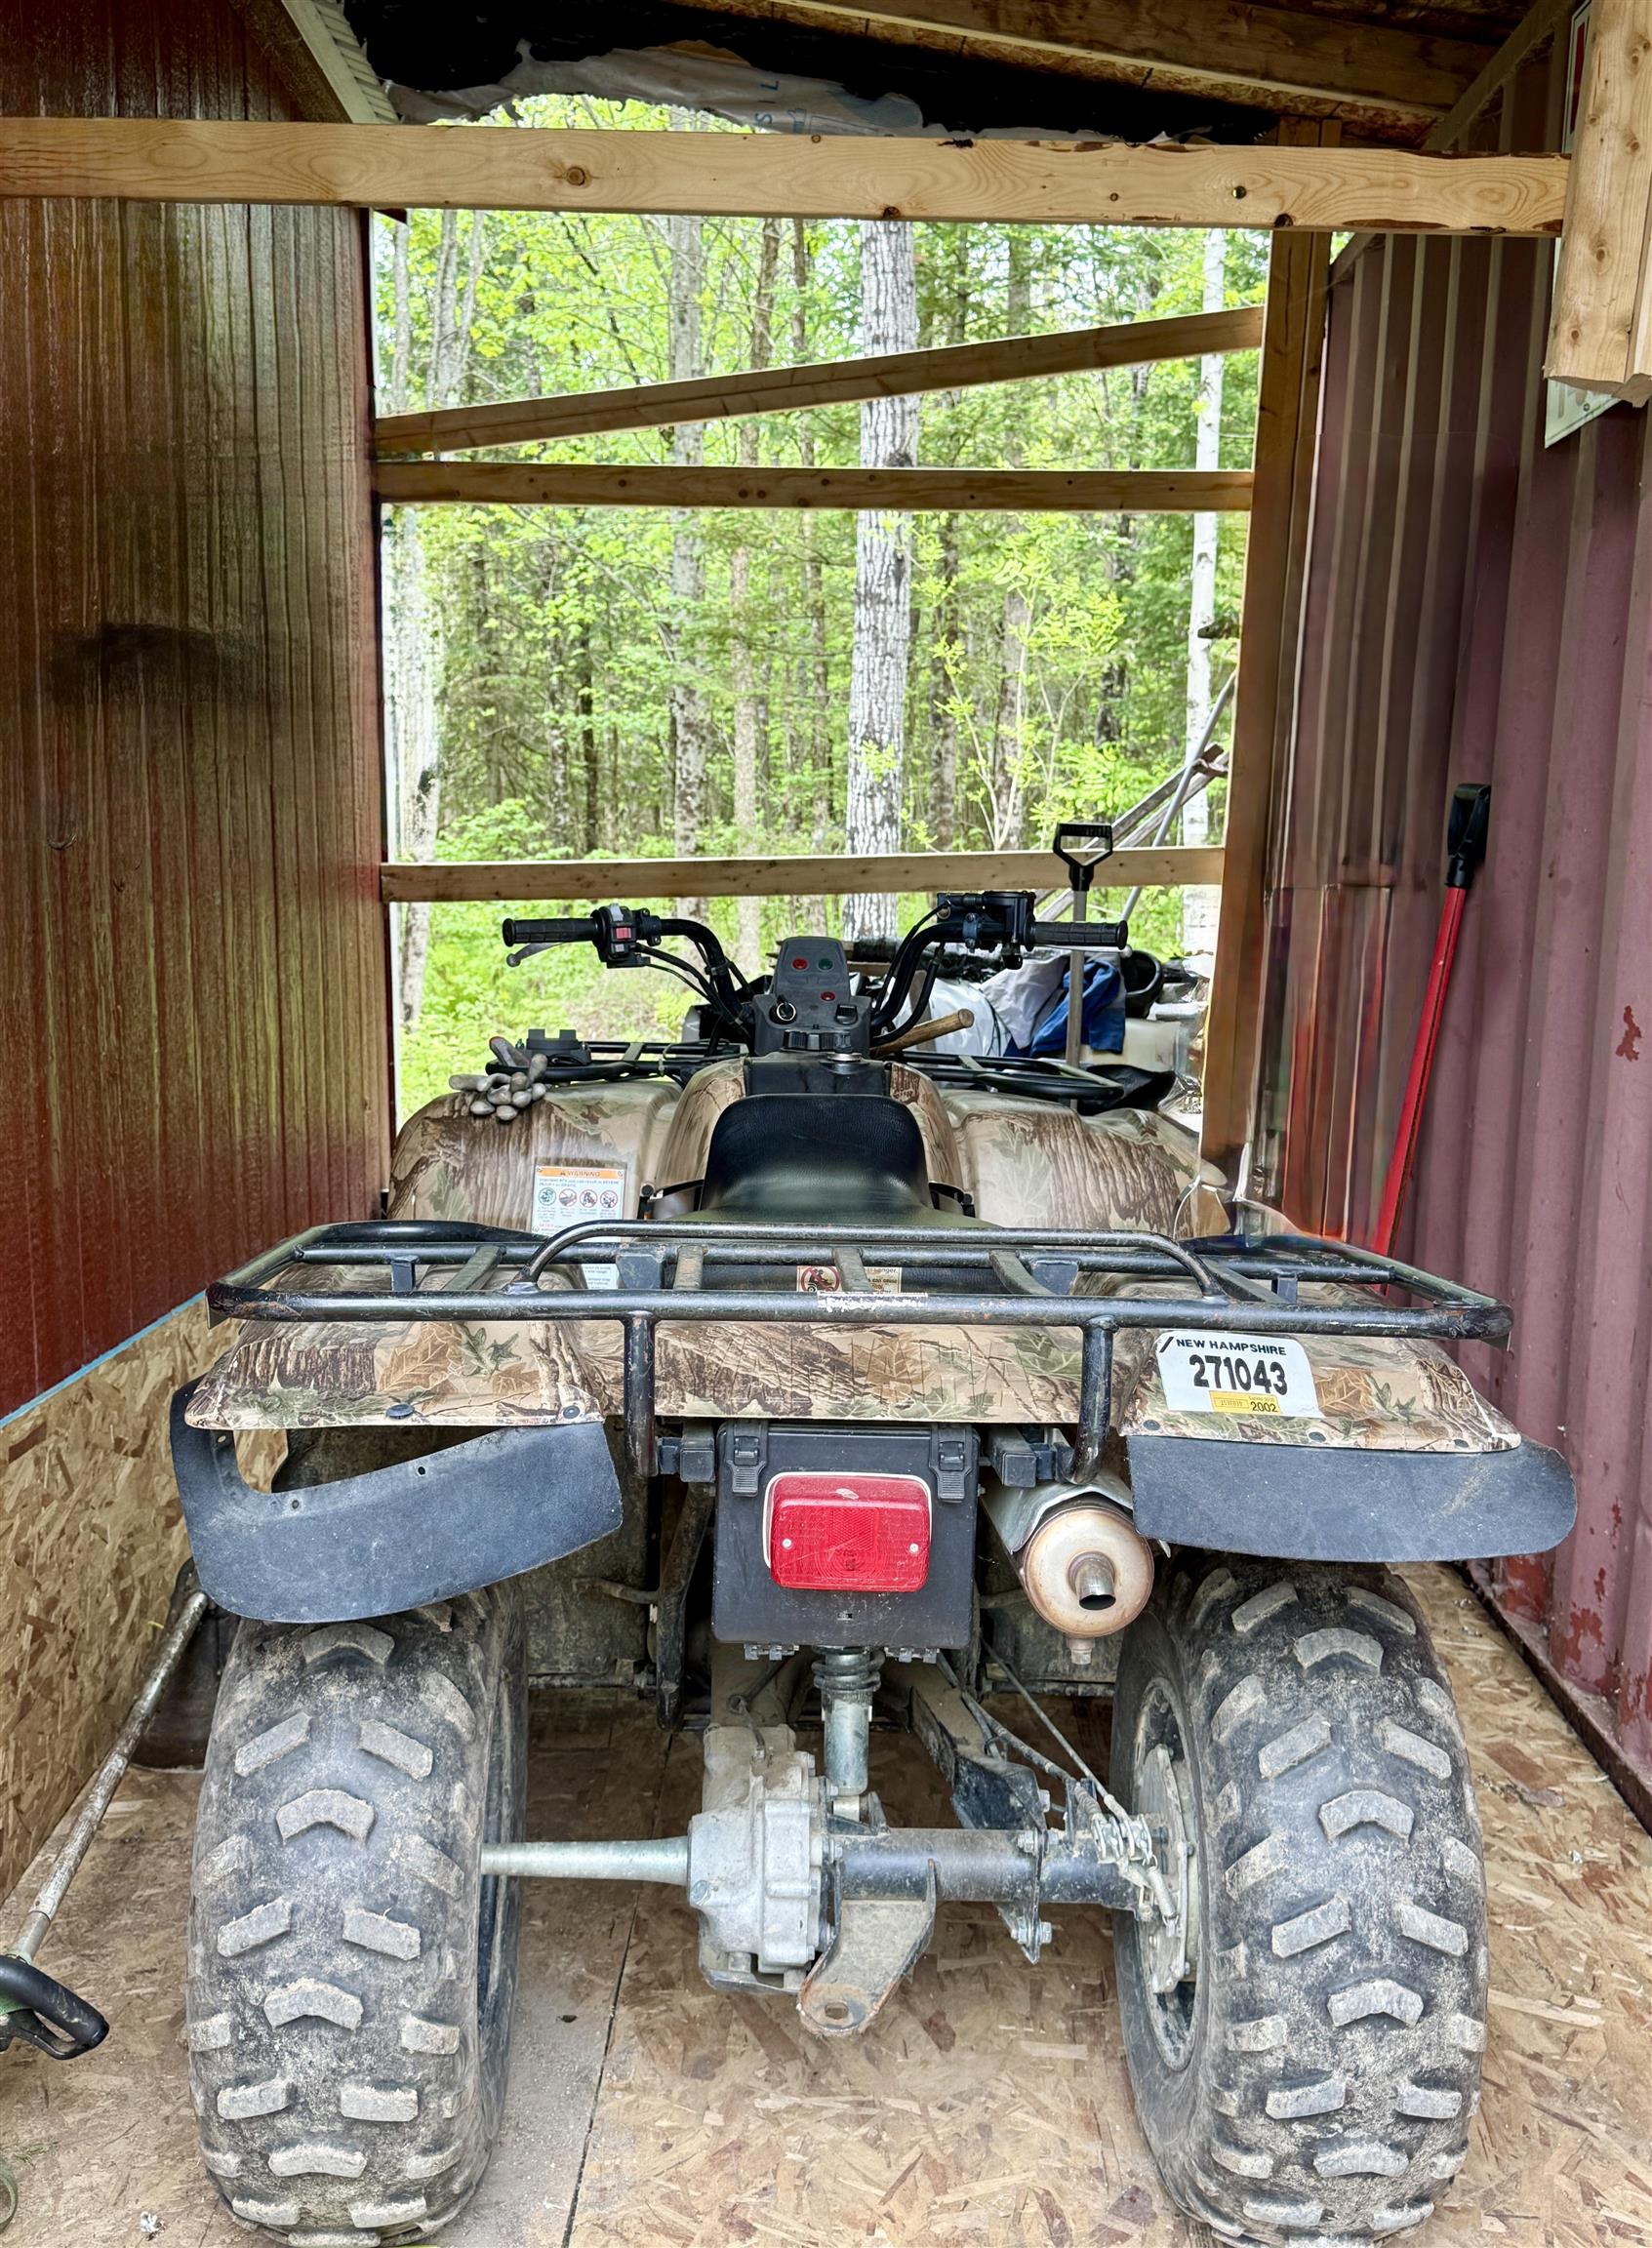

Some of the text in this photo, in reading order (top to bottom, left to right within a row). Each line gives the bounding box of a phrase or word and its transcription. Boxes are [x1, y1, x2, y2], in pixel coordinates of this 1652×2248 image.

[1176, 1339, 1287, 1356] NEW HAMPSHIRE
[1189, 1354, 1288, 1396] 271043
[1250, 1401, 1278, 1413] 2002
